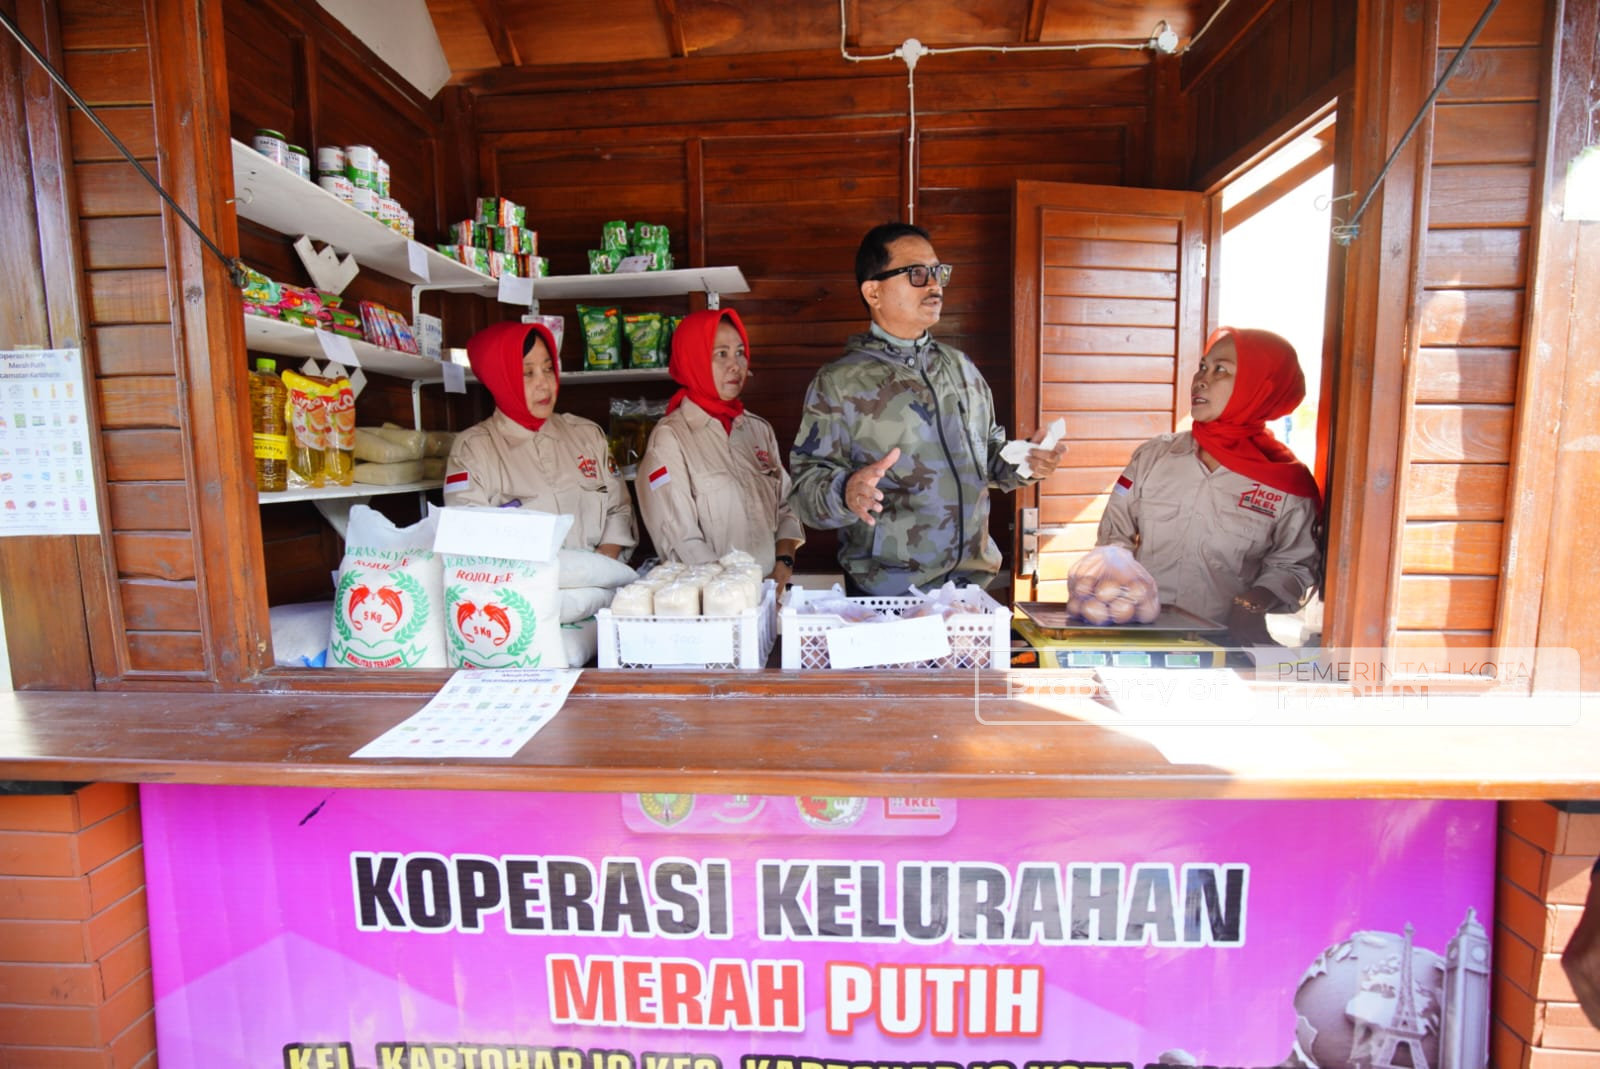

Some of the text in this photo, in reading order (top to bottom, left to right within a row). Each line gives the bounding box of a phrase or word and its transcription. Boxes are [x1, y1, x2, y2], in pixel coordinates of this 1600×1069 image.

[1257, 489, 1282, 502] KOP
[1253, 498, 1277, 511] KEL
[363, 610, 383, 625] 5 Kg
[473, 624, 492, 638] 5 Kg
[353, 854, 1246, 944] KOPERASI KELURAHAN
[549, 957, 1042, 1035] MERAH PUTIH
